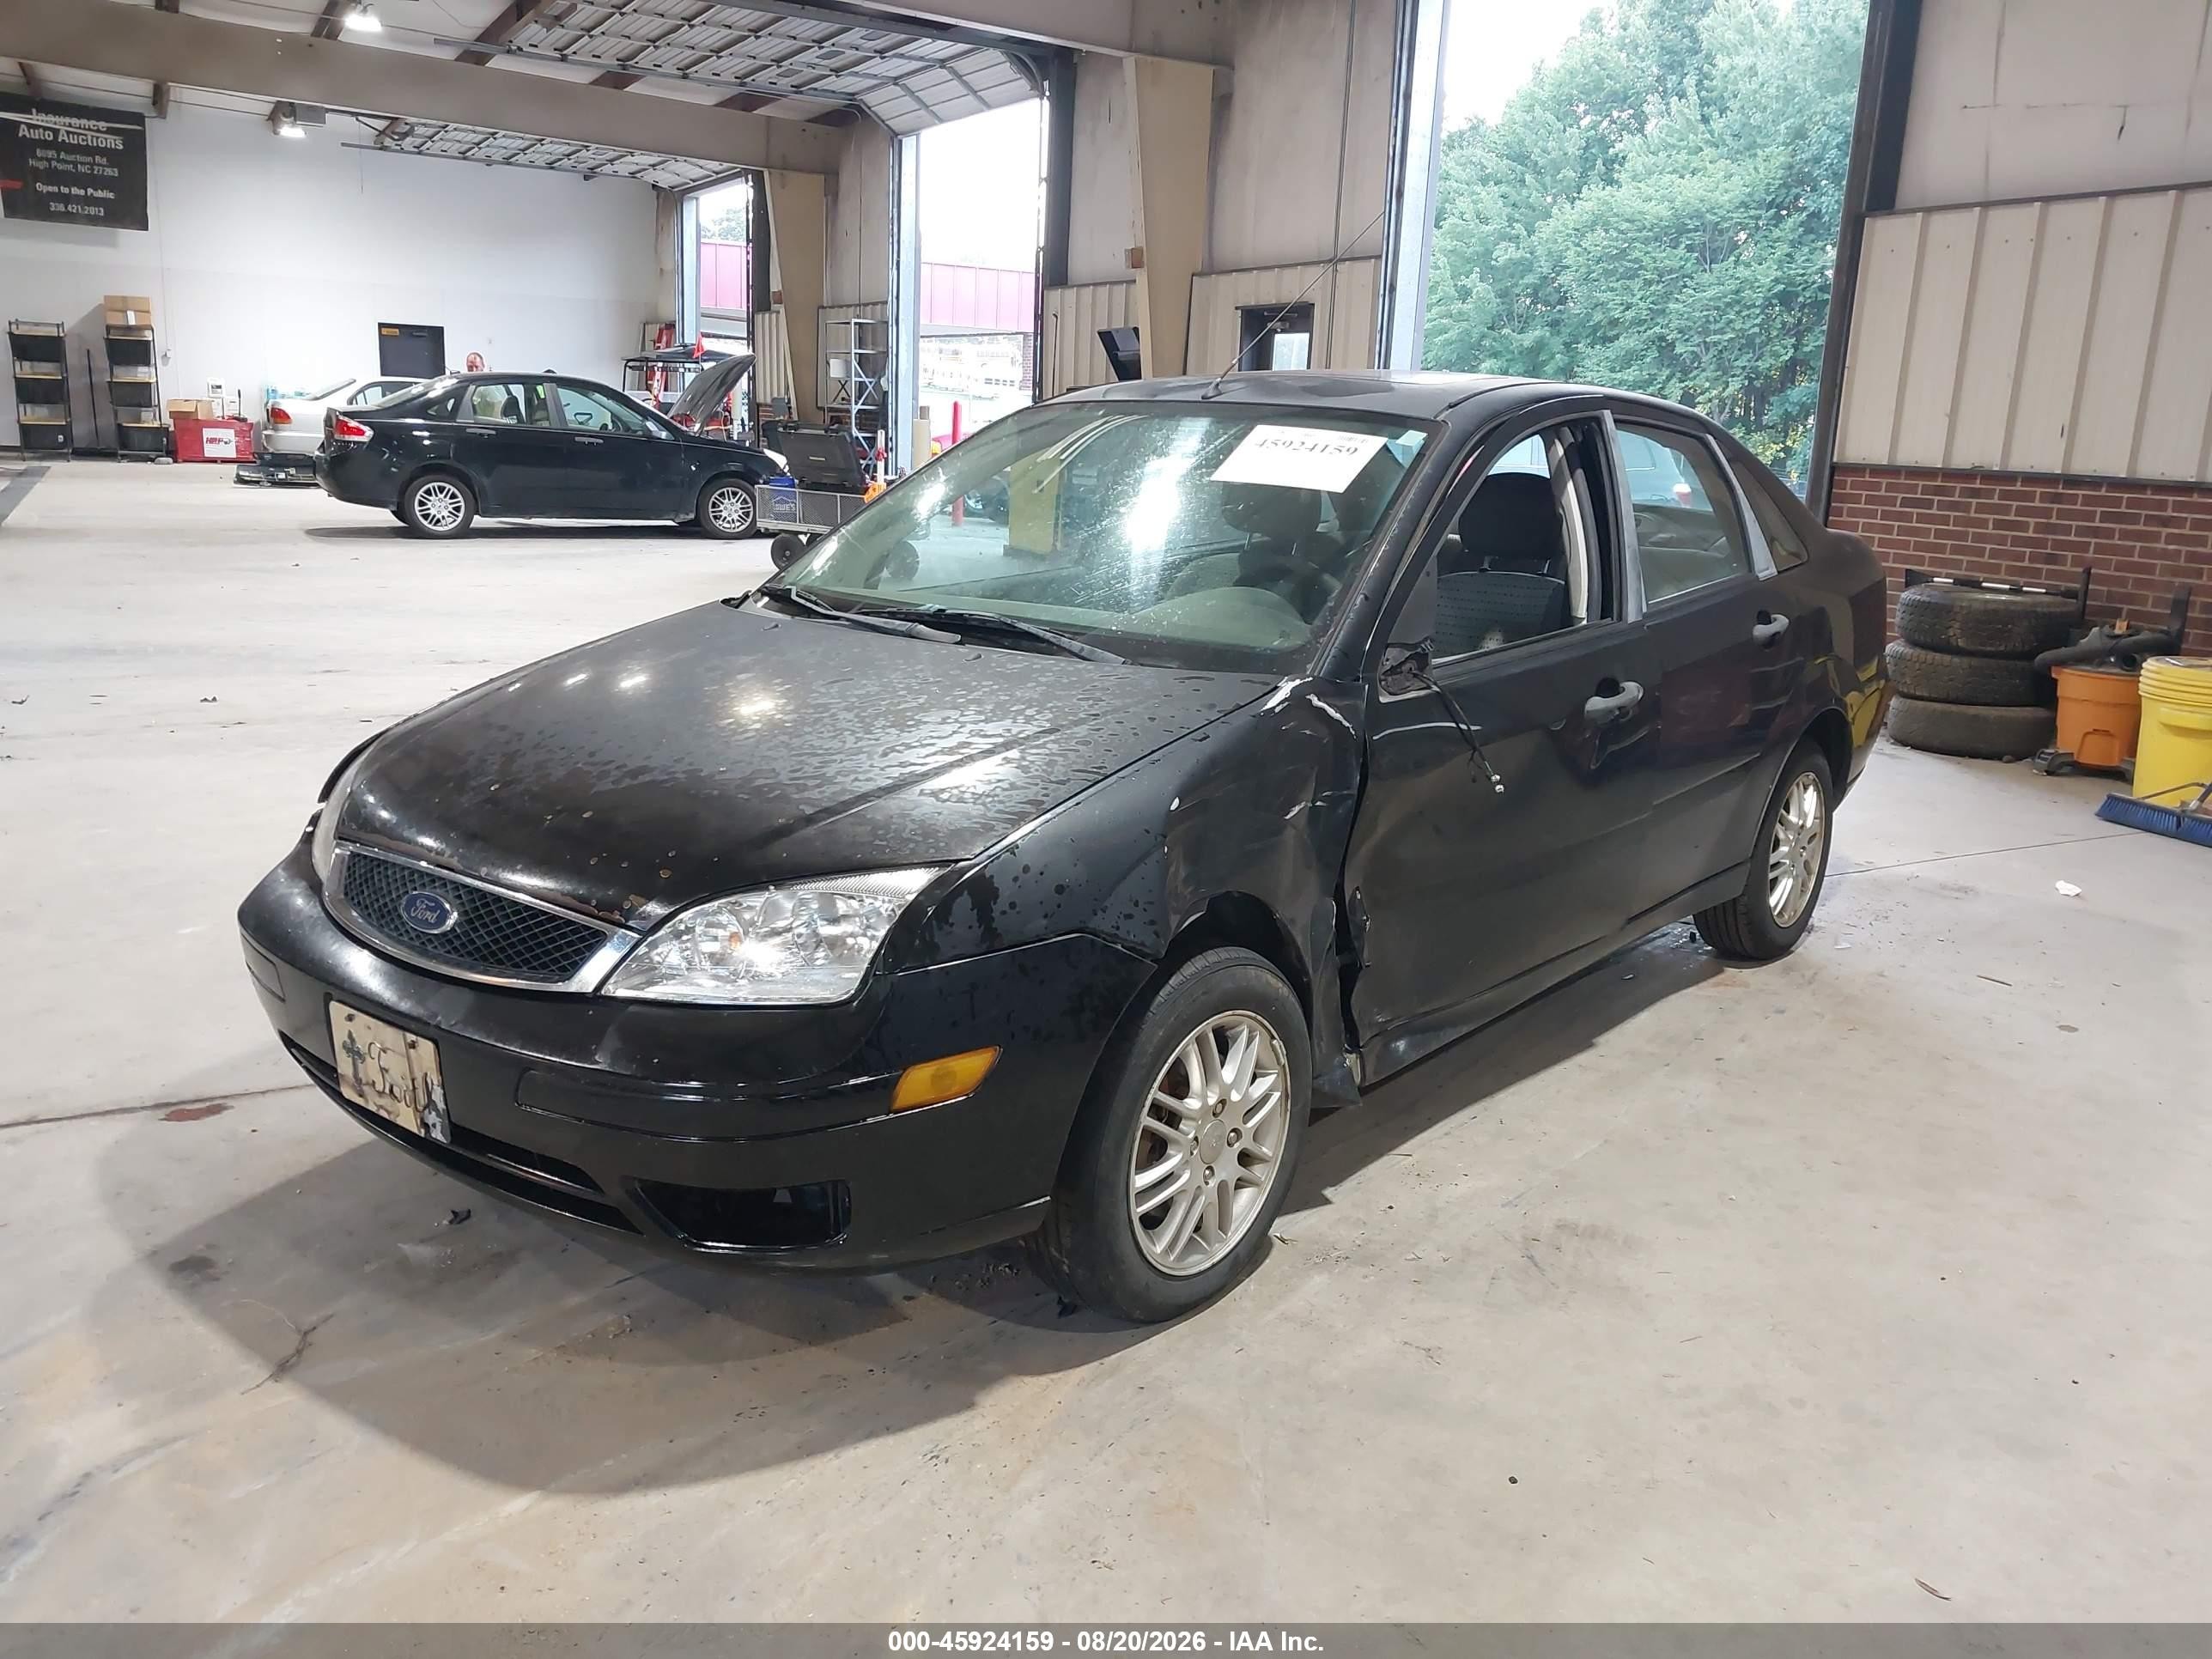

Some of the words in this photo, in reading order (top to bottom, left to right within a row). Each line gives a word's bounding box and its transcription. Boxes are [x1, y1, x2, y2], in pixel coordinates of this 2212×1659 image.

[32, 108, 107, 131] Insurance
[18, 124, 53, 141] Auto
[58, 129, 124, 149] Auctions
[28, 158, 48, 169] High
[52, 161, 76, 172] Point,
[77, 164, 91, 173] NC
[93, 166, 118, 177] 27263
[59, 151, 93, 163] Auction
[94, 155, 109, 165] Rd.
[36, 182, 58, 193] Open
[60, 185, 70, 194] to
[70, 186, 85, 196] the
[87, 188, 115, 199] Public
[1255, 439, 1358, 455] 45924159
[410, 898, 440, 923] Ford
